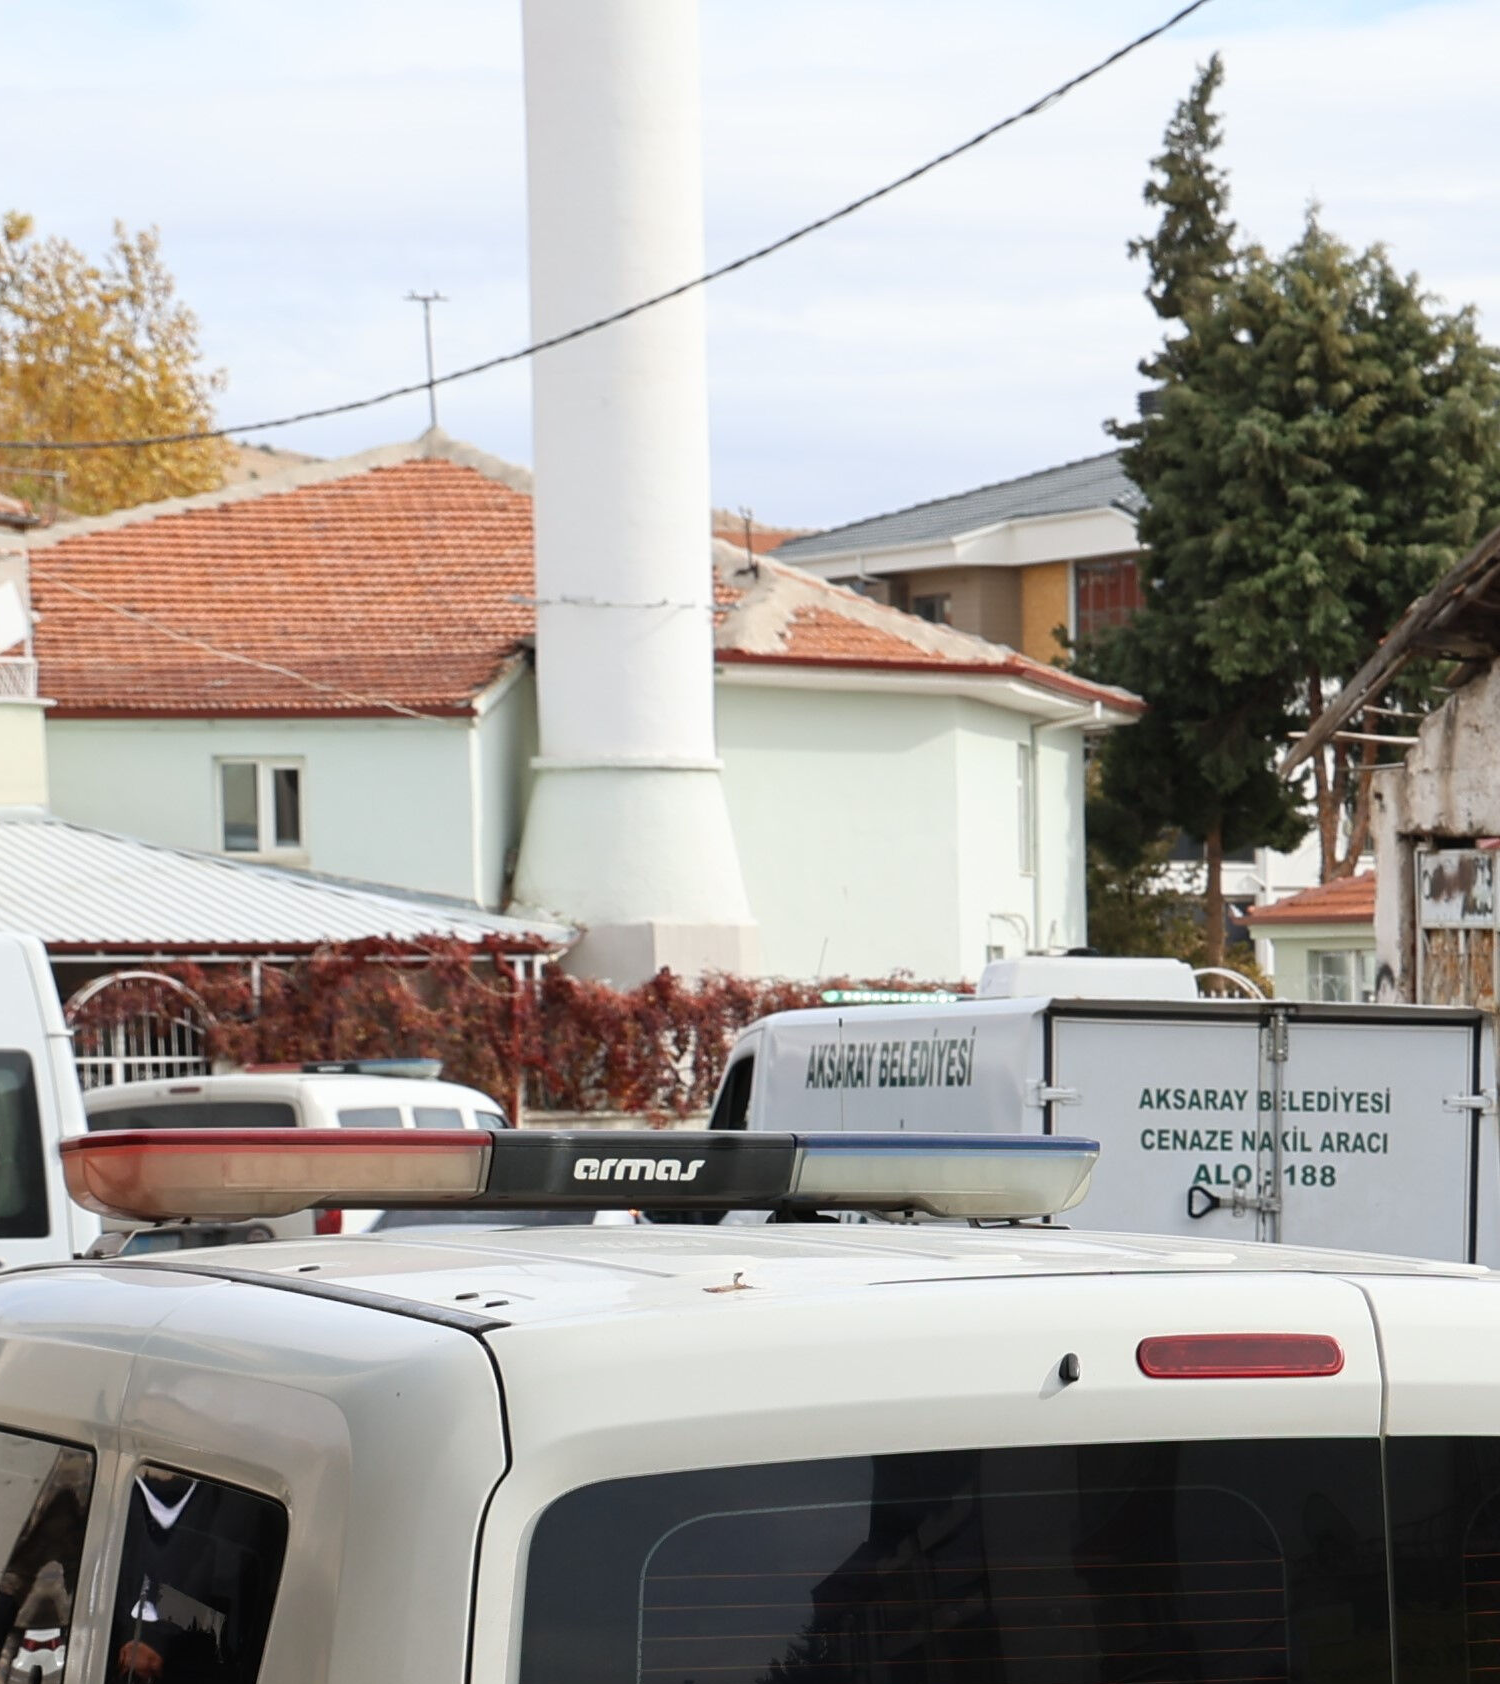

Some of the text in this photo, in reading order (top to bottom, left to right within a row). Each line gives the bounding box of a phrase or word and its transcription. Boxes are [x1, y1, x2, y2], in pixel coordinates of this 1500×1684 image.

[806, 1026, 977, 1089] AKSARAY BELEDİYESİ
[1139, 1087, 1248, 1111] AKSARAY
[1140, 1126, 1389, 1154] CENAZE NAKİL ARACI
[574, 1157, 705, 1182] armas
[1192, 1163, 1252, 1186] ALO
[1284, 1164, 1337, 1187] 188
